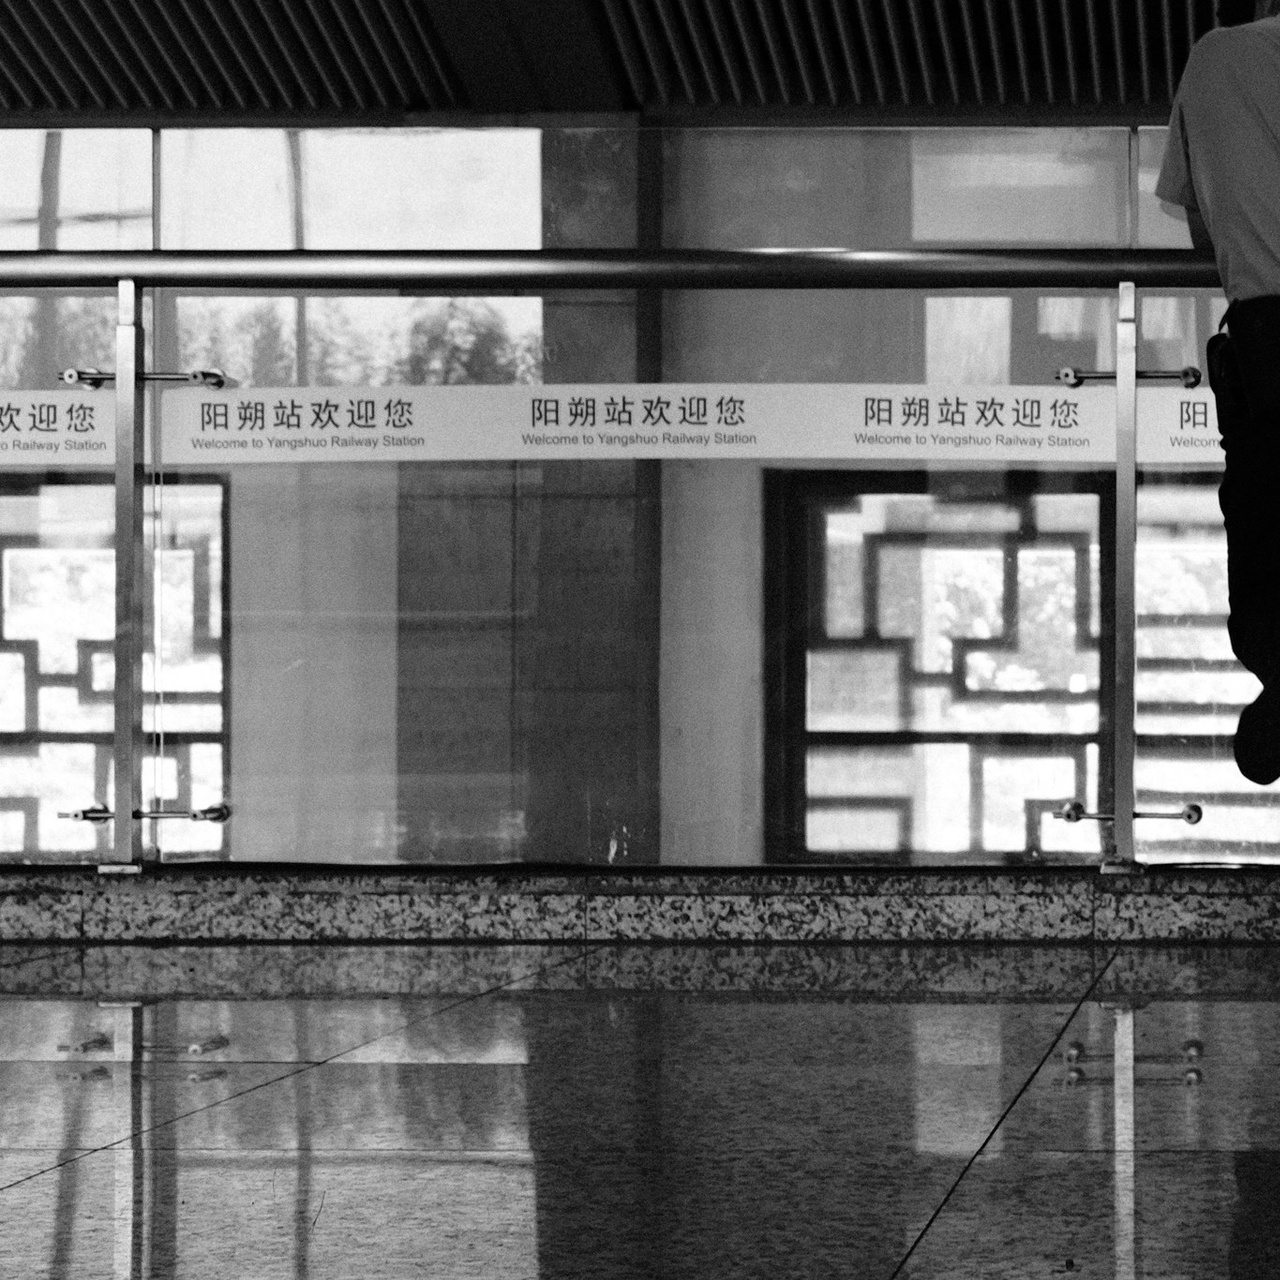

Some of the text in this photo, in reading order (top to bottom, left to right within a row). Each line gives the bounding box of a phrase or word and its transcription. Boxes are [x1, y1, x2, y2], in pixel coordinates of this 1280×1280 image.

[201, 399, 414, 431] 阳朔站欢迎您
[531, 396, 746, 427] 阳朔站欢迎您
[864, 397, 1079, 428] 阳朔站欢迎您
[12, 440, 60, 453] Railway
[64, 439, 107, 451] Station
[191, 435, 425, 450] Welcome to Yangshuo Railway Station
[522, 432, 757, 446] Welcome to Yangshuo Railway Station
[854, 433, 1090, 448] Welcome to Yangshuo Railway Station
[1169, 435, 1221, 448] Welcom
